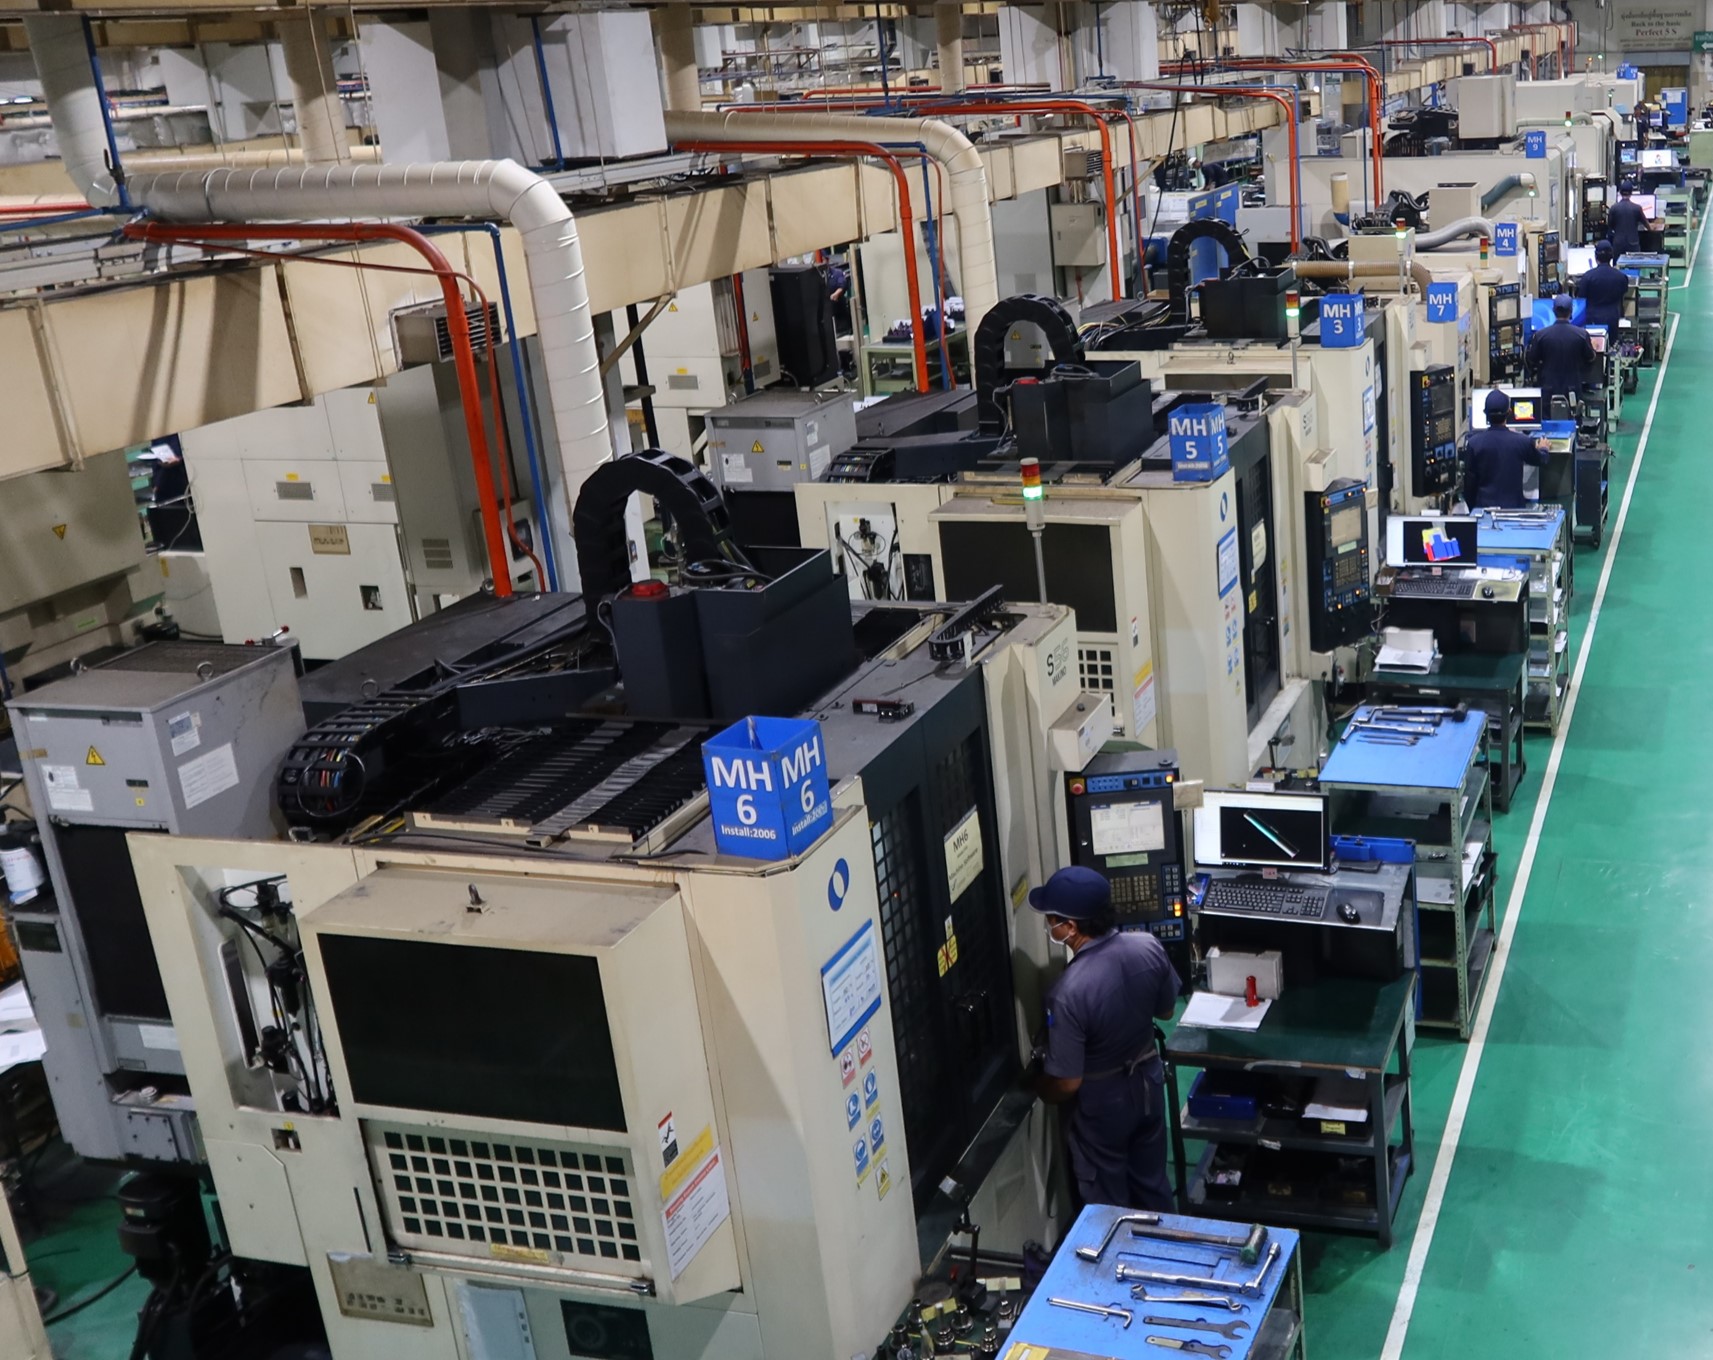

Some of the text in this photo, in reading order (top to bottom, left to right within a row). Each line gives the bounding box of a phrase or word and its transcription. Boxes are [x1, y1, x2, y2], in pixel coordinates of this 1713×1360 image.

[1532, 143, 1539, 151] 9
[1496, 228, 1514, 238] MH
[1502, 238, 1509, 248] 4
[1429, 293, 1452, 305] MH
[1323, 303, 1351, 318] MH
[1436, 304, 1445, 316] 7
[1333, 319, 1344, 334] 3
[1170, 417, 1207, 436] MH
[1211, 412, 1225, 436] MH
[1185, 440, 1198, 460] 5
[1217, 434, 1224, 455] 5
[781, 735, 821, 790] MH
[711, 756, 773, 792] MH
[800, 779, 815, 813] 6
[736, 794, 758, 825] 6
[720, 824, 777, 840] Install:2006
[952, 828, 969, 853] MH6
